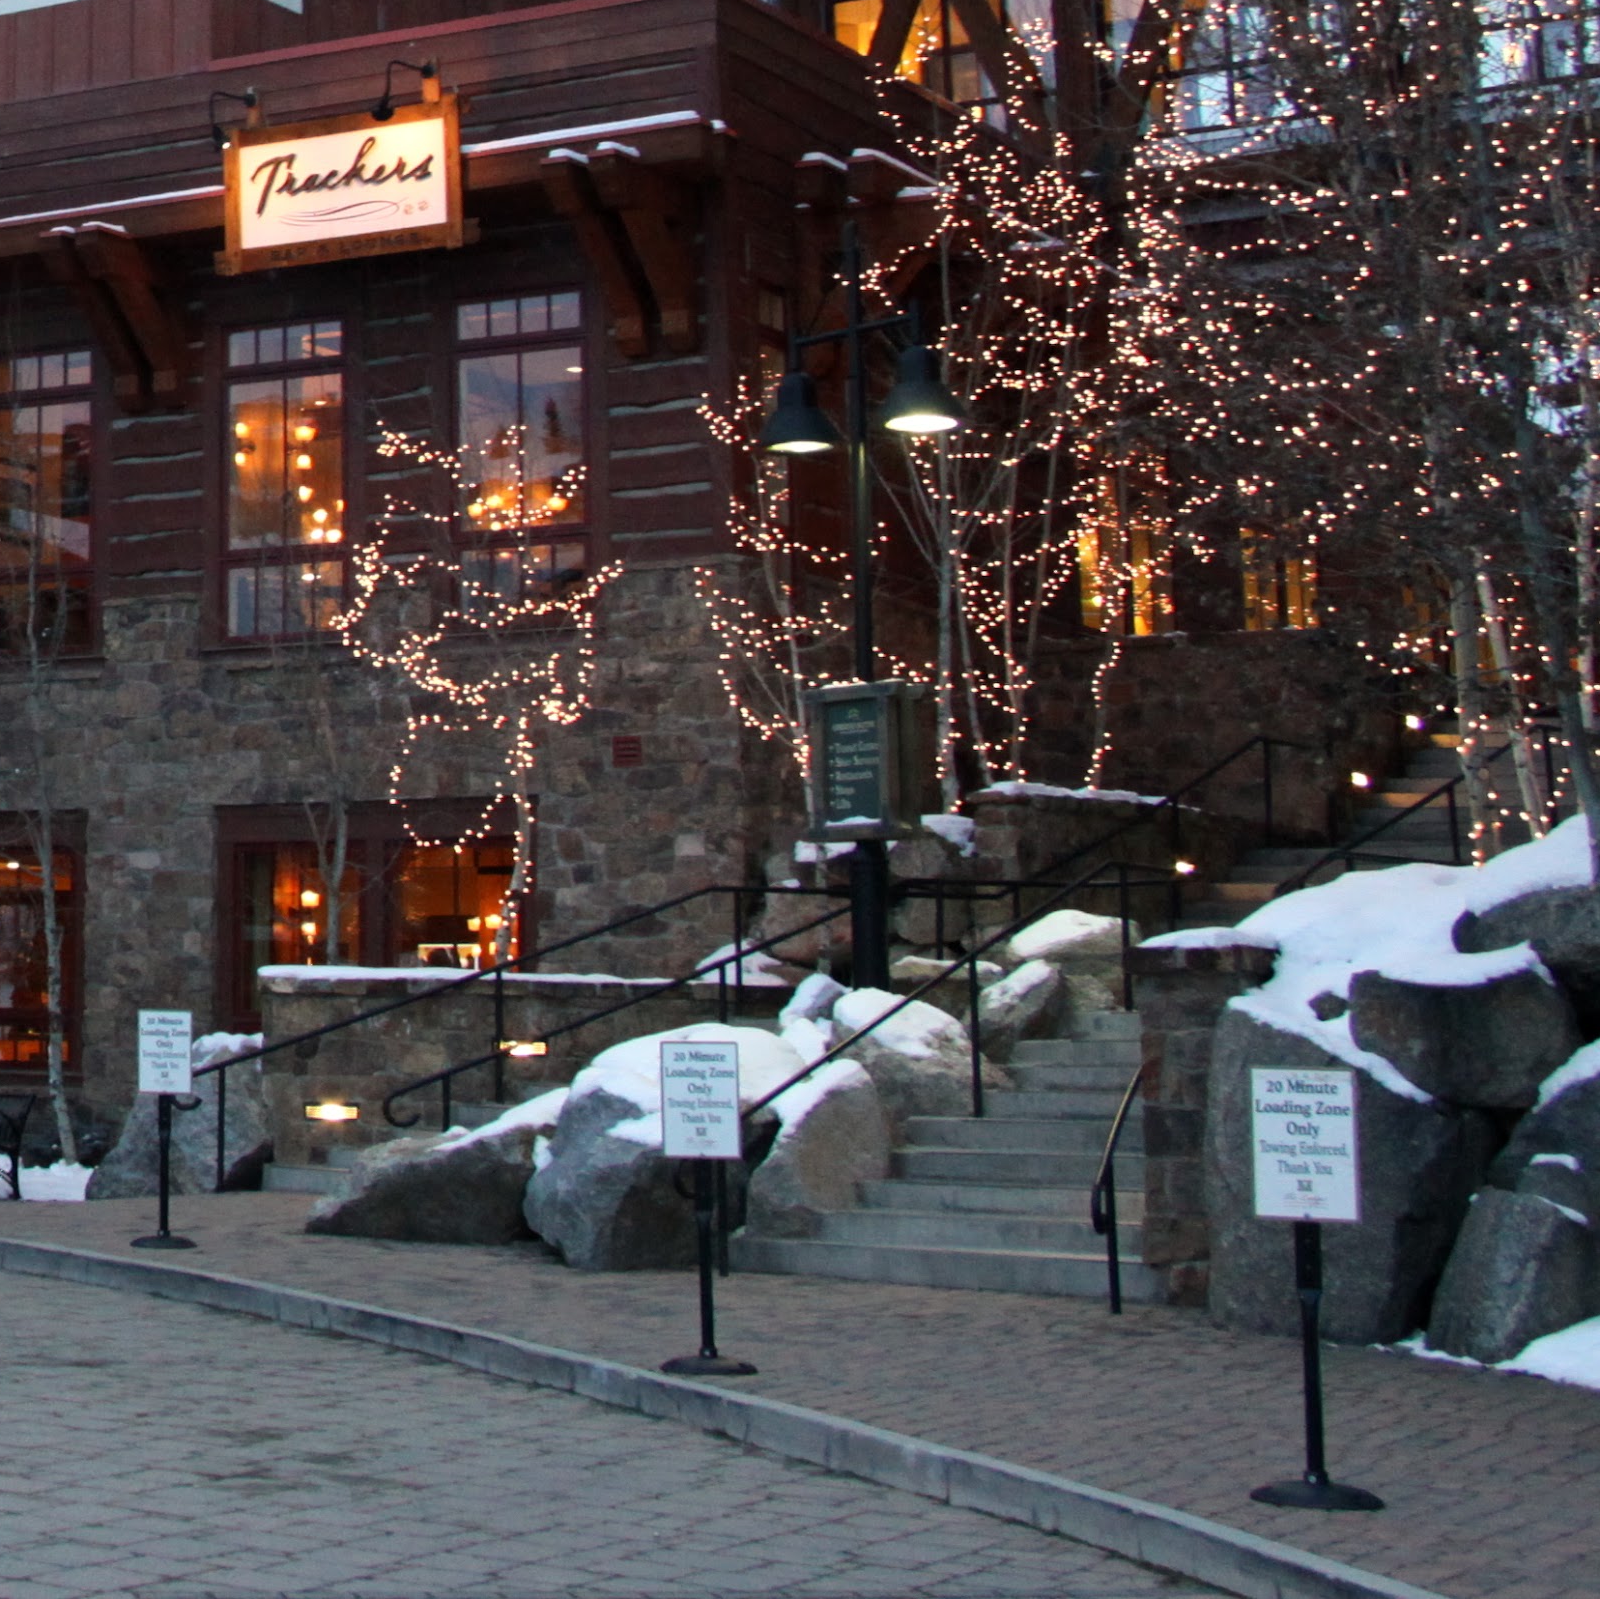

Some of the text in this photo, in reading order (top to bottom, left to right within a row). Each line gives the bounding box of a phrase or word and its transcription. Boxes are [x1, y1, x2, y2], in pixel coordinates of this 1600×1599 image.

[251, 136, 435, 218] Trackers
[689, 1050, 726, 1062] Minute
[665, 1066, 736, 1080] Loading Zone
[687, 1082, 713, 1096] Only
[1266, 1079, 1338, 1095] 20 Minute
[1255, 1099, 1350, 1118] Loading Zone
[1286, 1121, 1320, 1139] Only
[1259, 1140, 1297, 1157] Towing
[1276, 1160, 1333, 1175] Thank You
